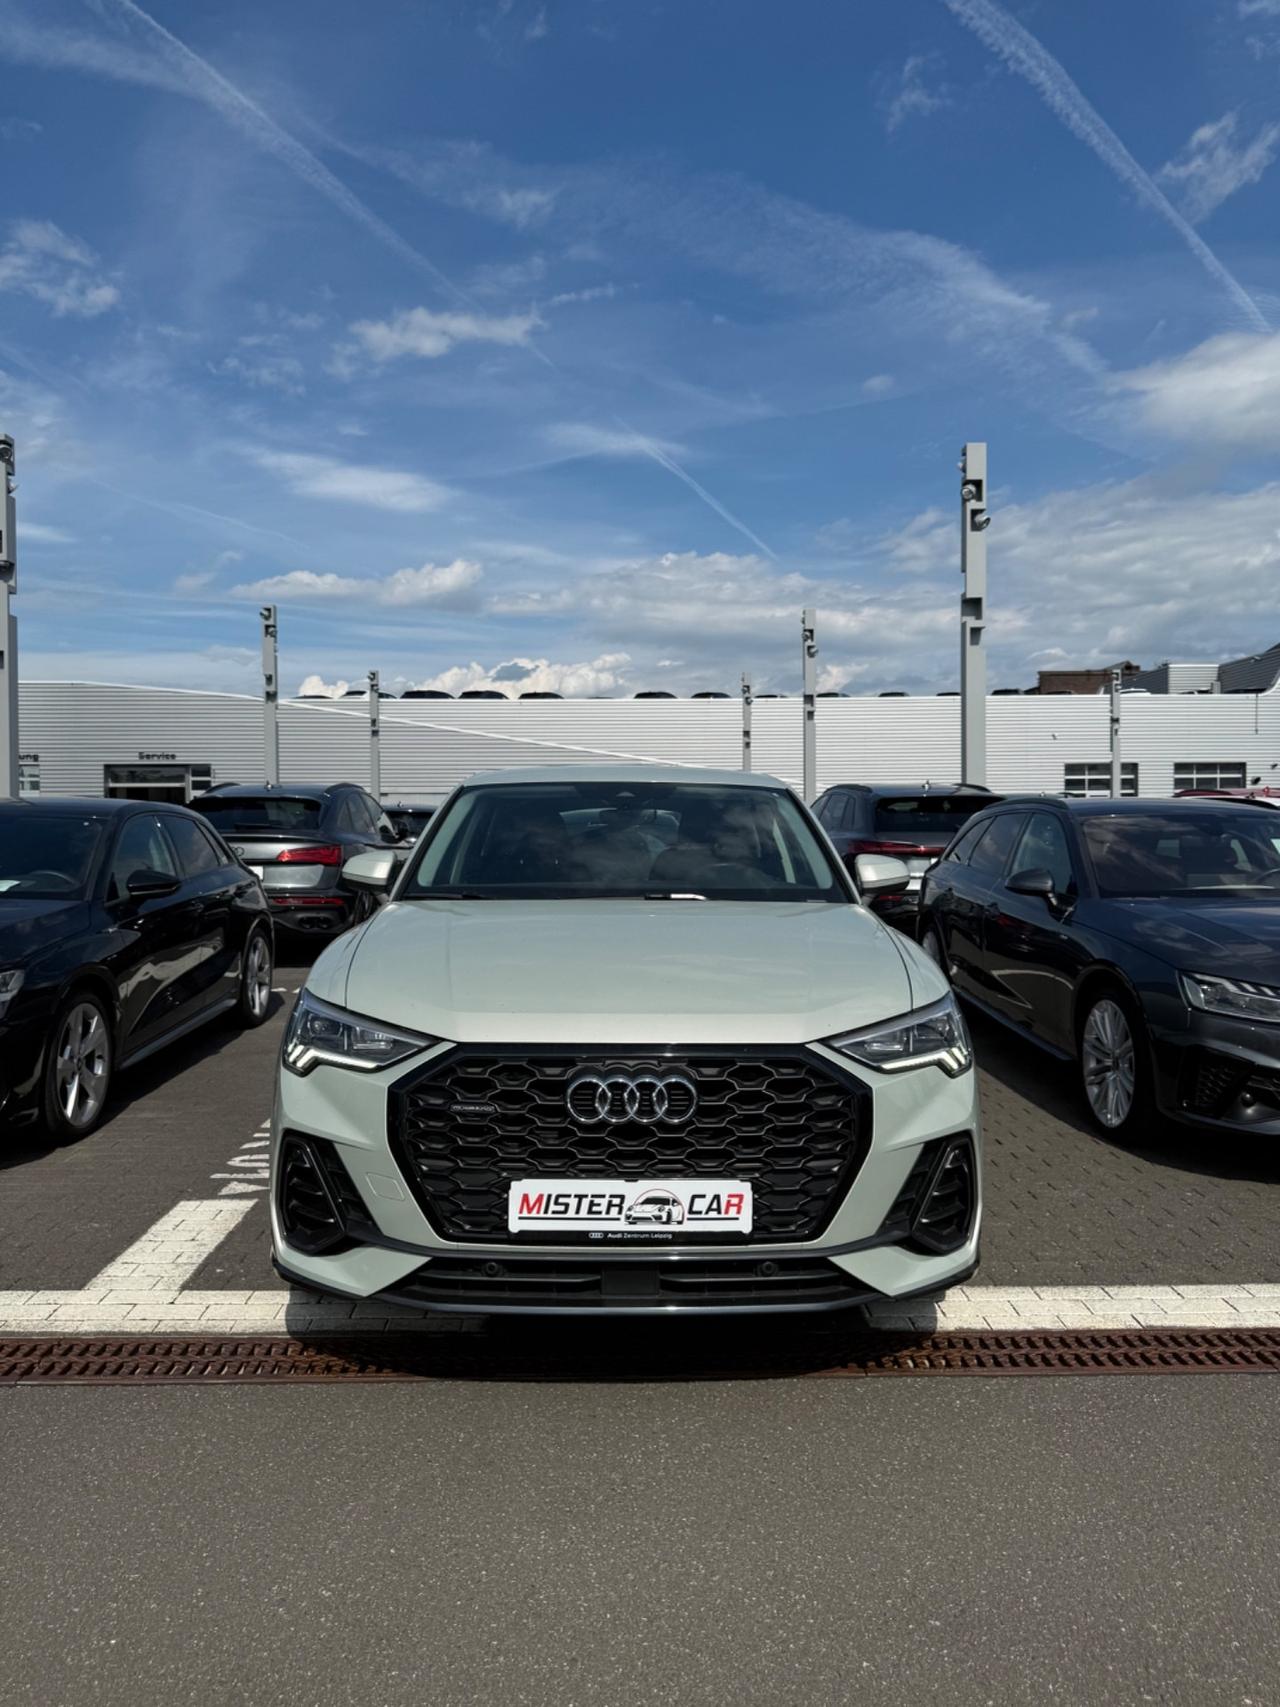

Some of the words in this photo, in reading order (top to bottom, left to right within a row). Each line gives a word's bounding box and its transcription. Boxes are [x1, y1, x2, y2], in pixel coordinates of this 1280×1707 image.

[138, 752, 176, 760] Service
[518, 1193, 626, 1215] MISTER
[687, 1193, 744, 1215] CAR
[650, 1232, 673, 1240] Leipzig
